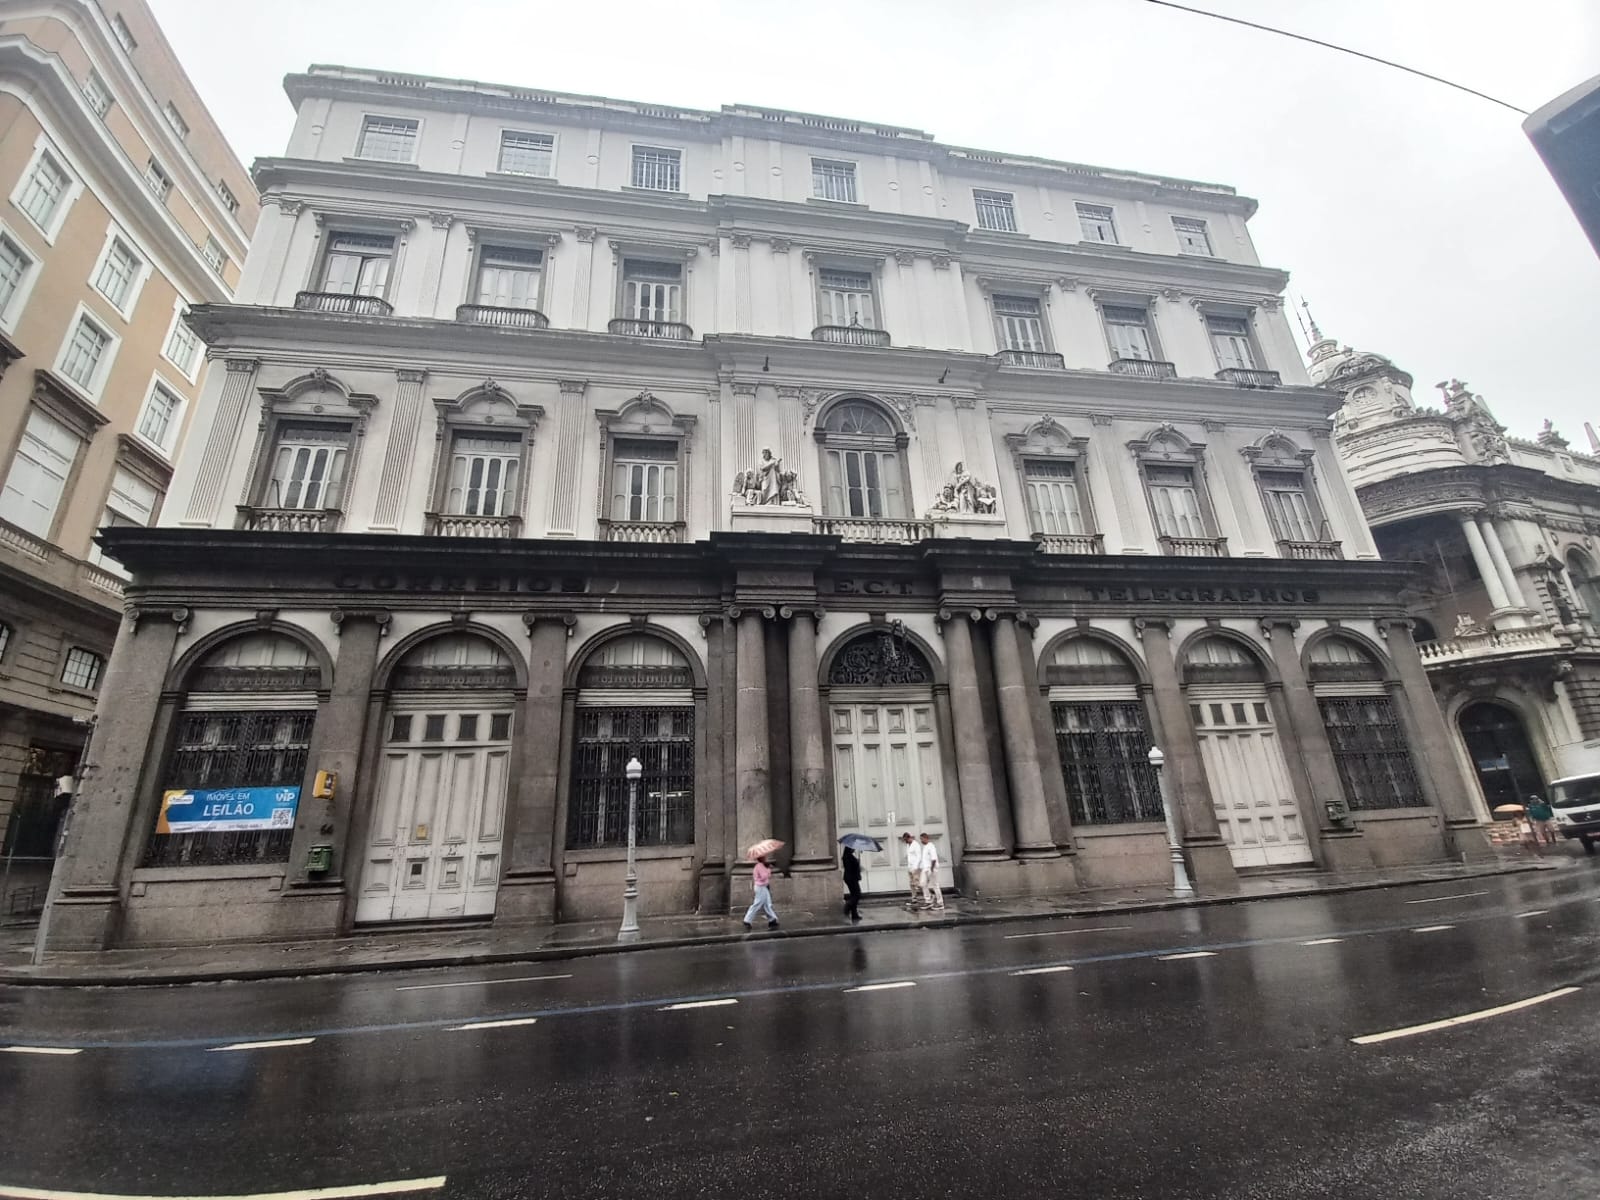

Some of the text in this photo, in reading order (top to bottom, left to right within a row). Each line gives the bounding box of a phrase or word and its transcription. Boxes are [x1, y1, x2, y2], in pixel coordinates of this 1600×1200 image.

[335, 574, 588, 592] CORREIOS
[1085, 585, 1320, 603] TELEGRAPHOS
[206, 791, 250, 801] IMÓVEL EM
[203, 800, 254, 816] LEILÃO
